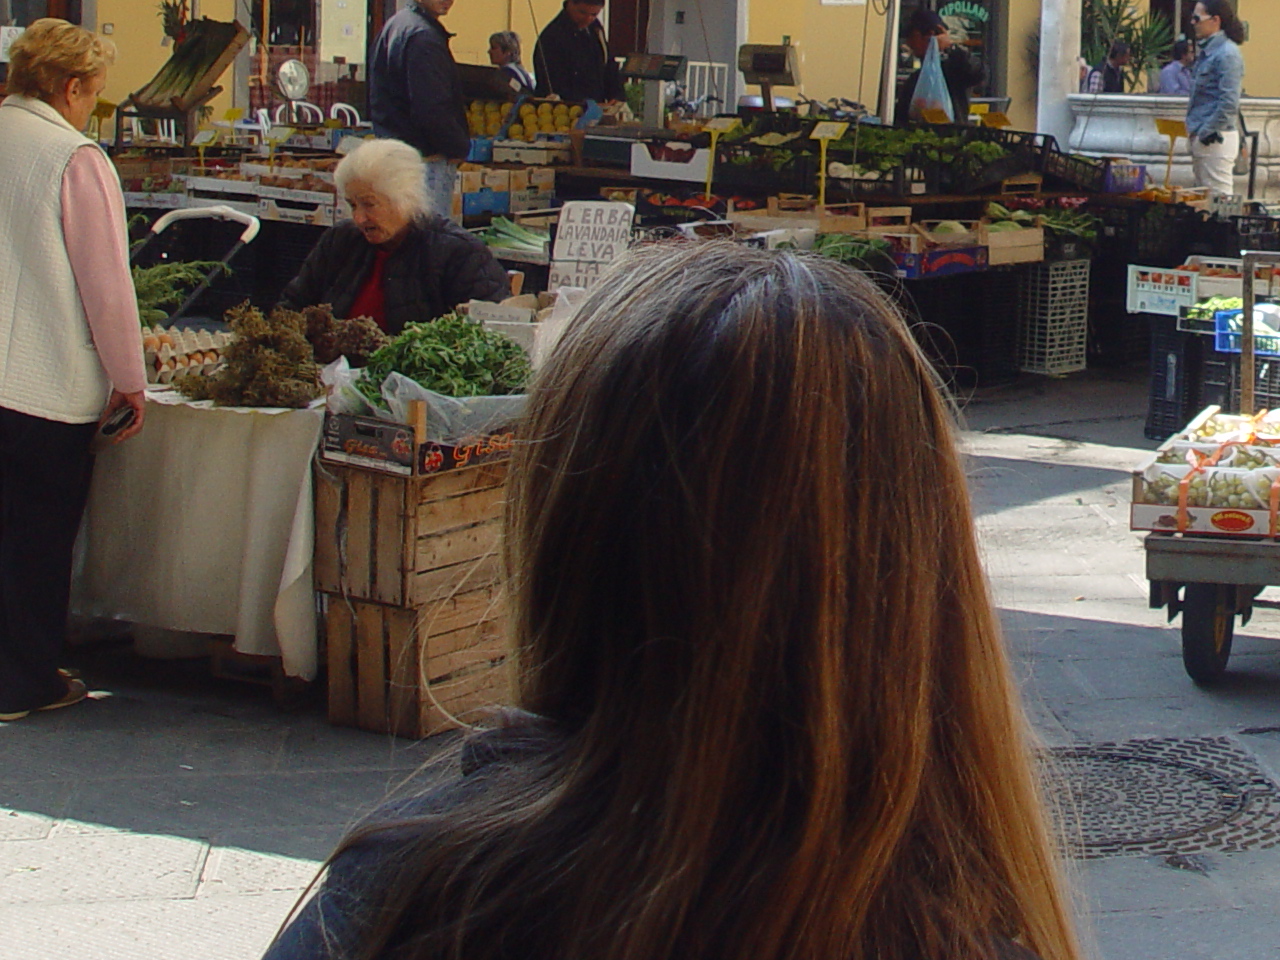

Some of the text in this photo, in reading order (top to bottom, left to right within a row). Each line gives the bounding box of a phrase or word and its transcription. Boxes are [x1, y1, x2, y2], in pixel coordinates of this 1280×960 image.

[558, 225, 628, 243] LAVANDAIA
[566, 241, 614, 260] LEVA
[575, 260, 599, 275] LA
